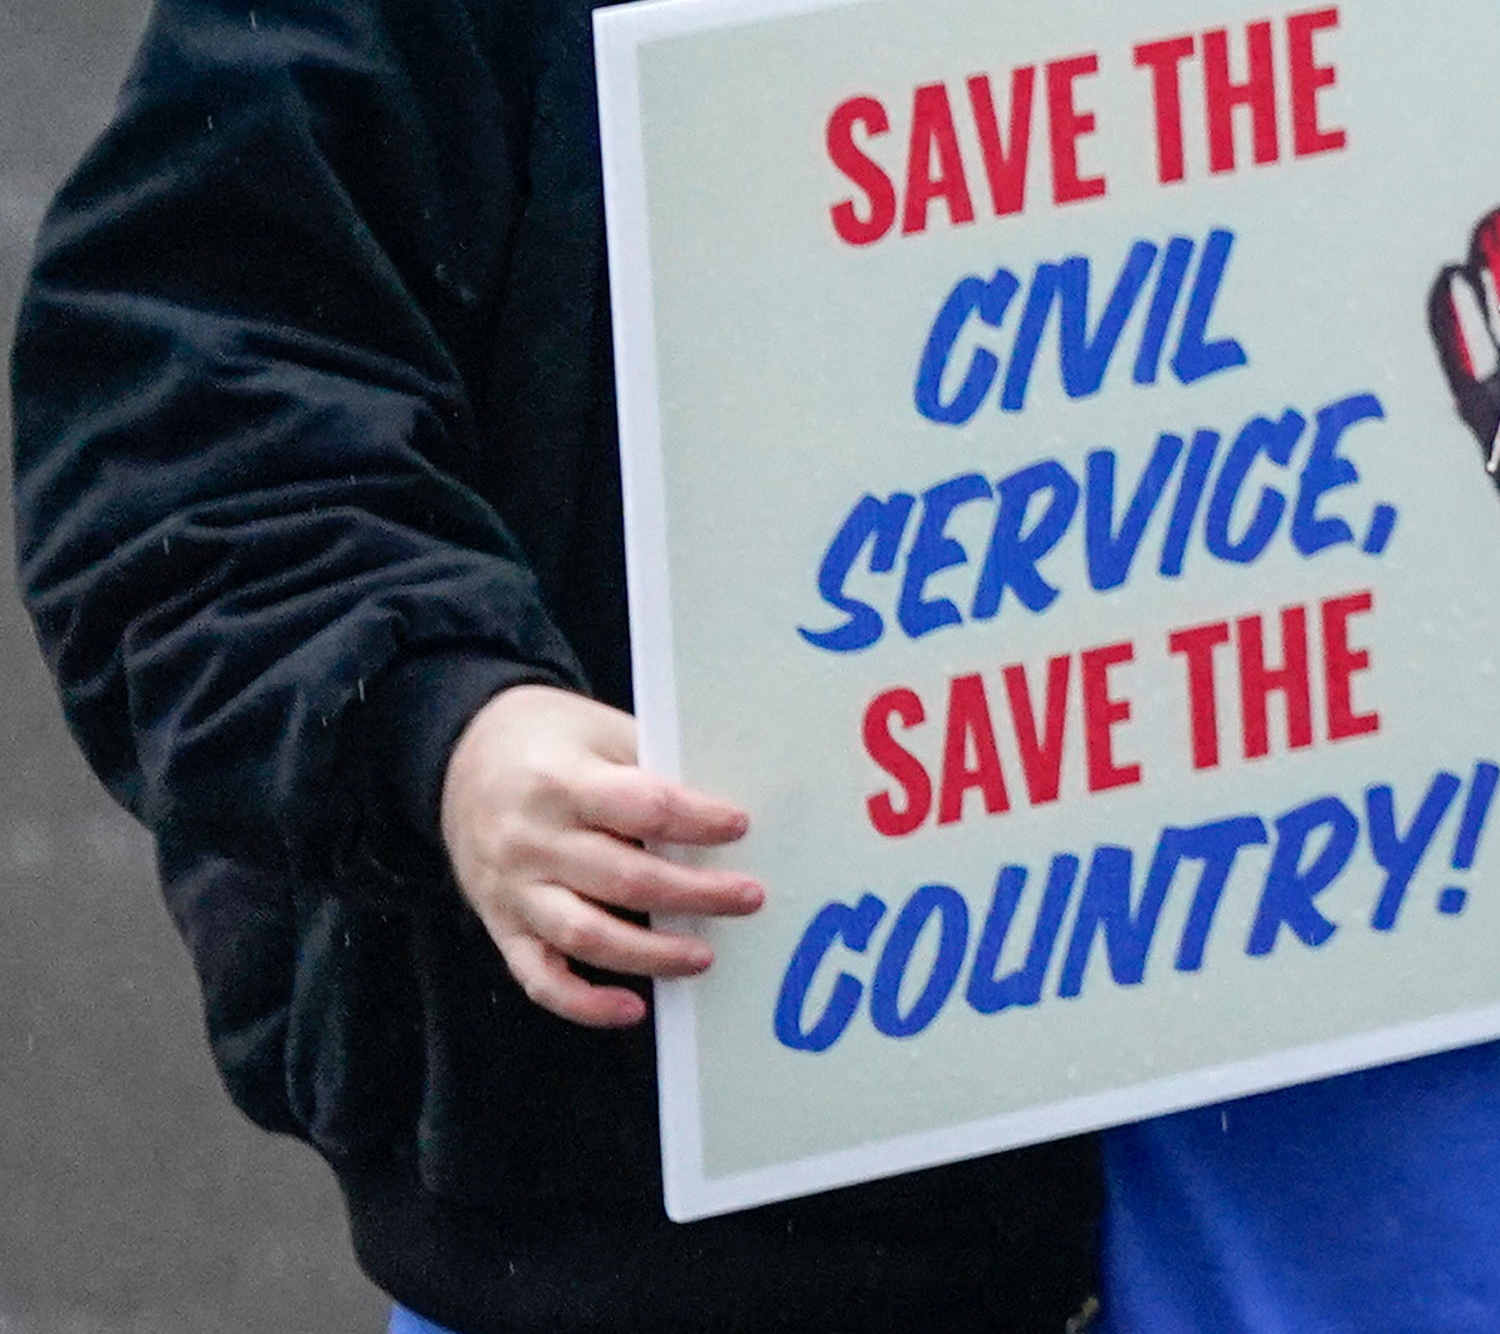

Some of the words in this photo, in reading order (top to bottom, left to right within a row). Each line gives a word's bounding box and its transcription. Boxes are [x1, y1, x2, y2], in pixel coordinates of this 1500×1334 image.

[826, 54, 1106, 246] SAVE
[1133, 8, 1346, 184] THE
[912, 226, 1248, 427] CIVIL
[796, 391, 1400, 654] SERVICE,
[862, 642, 1142, 837] SAVE
[1168, 591, 1380, 769] THE
